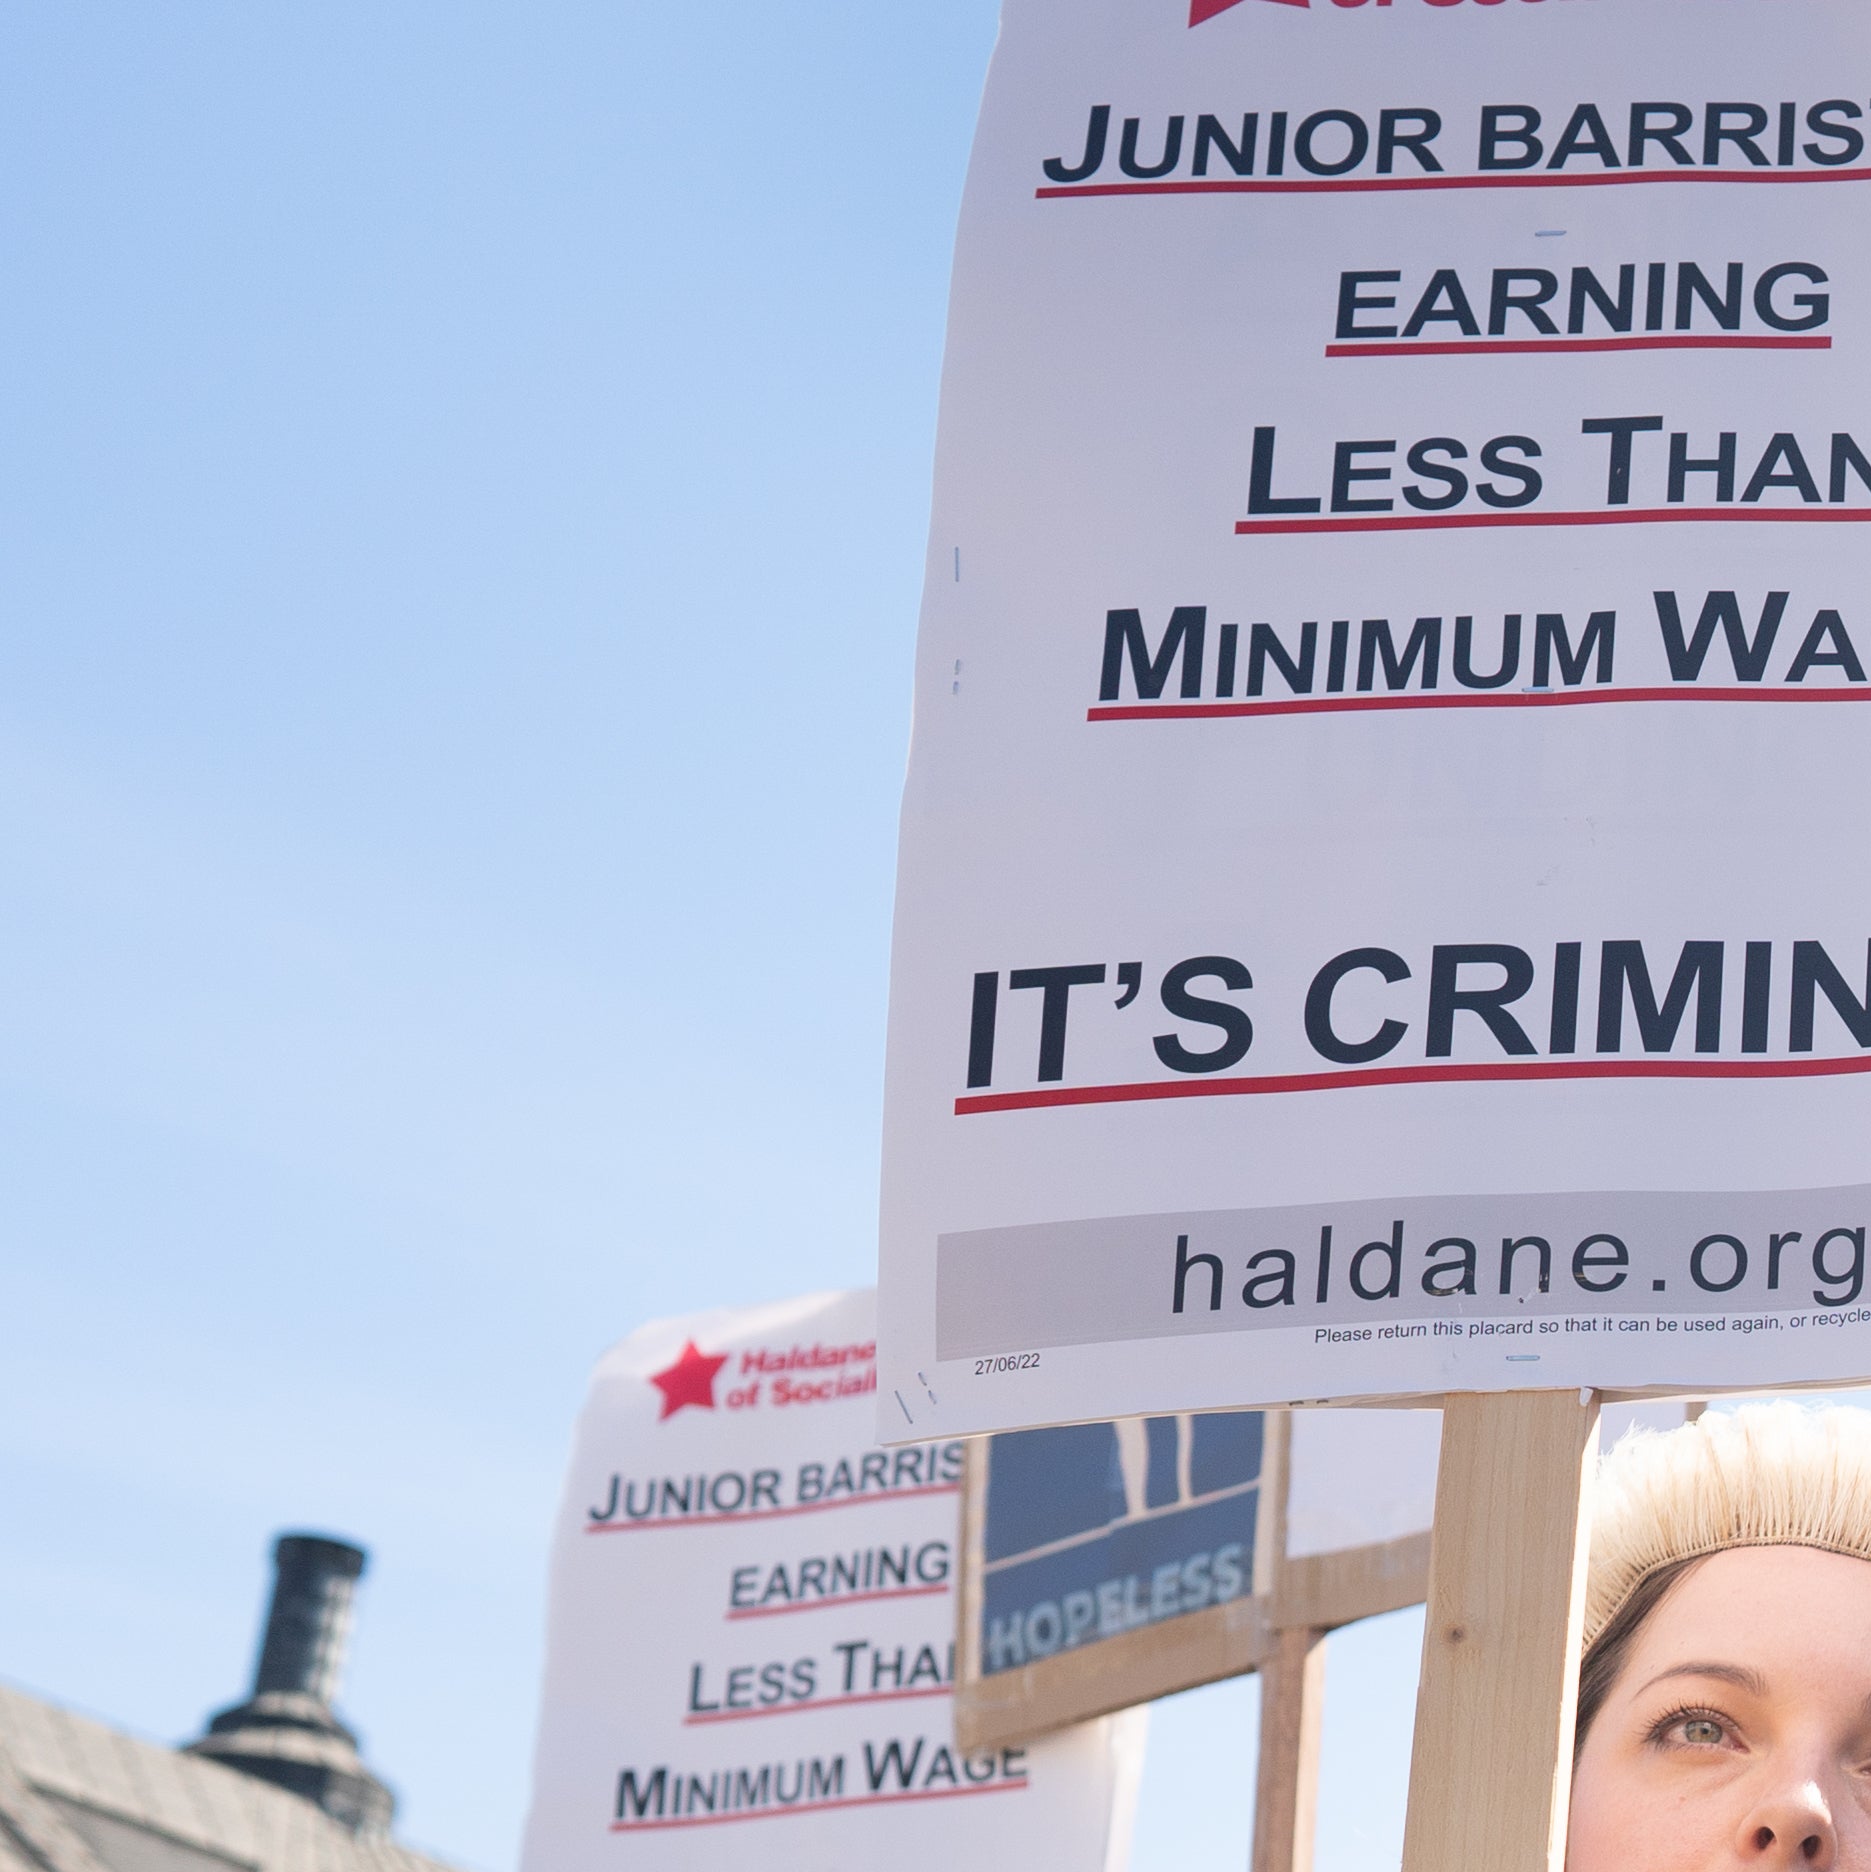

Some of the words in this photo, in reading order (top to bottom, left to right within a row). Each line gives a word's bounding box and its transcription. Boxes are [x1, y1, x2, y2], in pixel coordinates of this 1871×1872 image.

[1042, 104, 1444, 184] JUNIOR
[1333, 260, 1831, 341] EARNING
[1246, 424, 1545, 514] LESS
[1098, 604, 1616, 702] MINIMUM
[965, 955, 1255, 1090] IT’S
[1170, 1220, 1869, 1312] haldane.org
[975, 1352, 1040, 1376] 27/06/22
[1314, 1326, 1372, 1345] Please
[1377, 1323, 1428, 1340] return
[1433, 1320, 1463, 1336] this
[1469, 1319, 1533, 1339] placard
[1538, 1321, 1559, 1334] so
[1564, 1317, 1597, 1332] that
[1602, 1316, 1613, 1332] it
[1618, 1319, 1650, 1332] can
[1656, 1315, 1678, 1332] be
[1683, 1315, 1726, 1332] used
[1731, 1315, 1784, 1335] again,
[1790, 1315, 1807, 1328] or
[1812, 1307, 1871, 1327] recycle
[726, 1383, 759, 1408] of
[588, 1468, 779, 1524] JUNIOR
[730, 1542, 948, 1609] EARNING
[987, 1542, 1245, 1669] HOPELESS
[687, 1658, 815, 1717] LESS
[612, 1755, 843, 1822] MINIMUM
[863, 1738, 1028, 1795] WAGE
